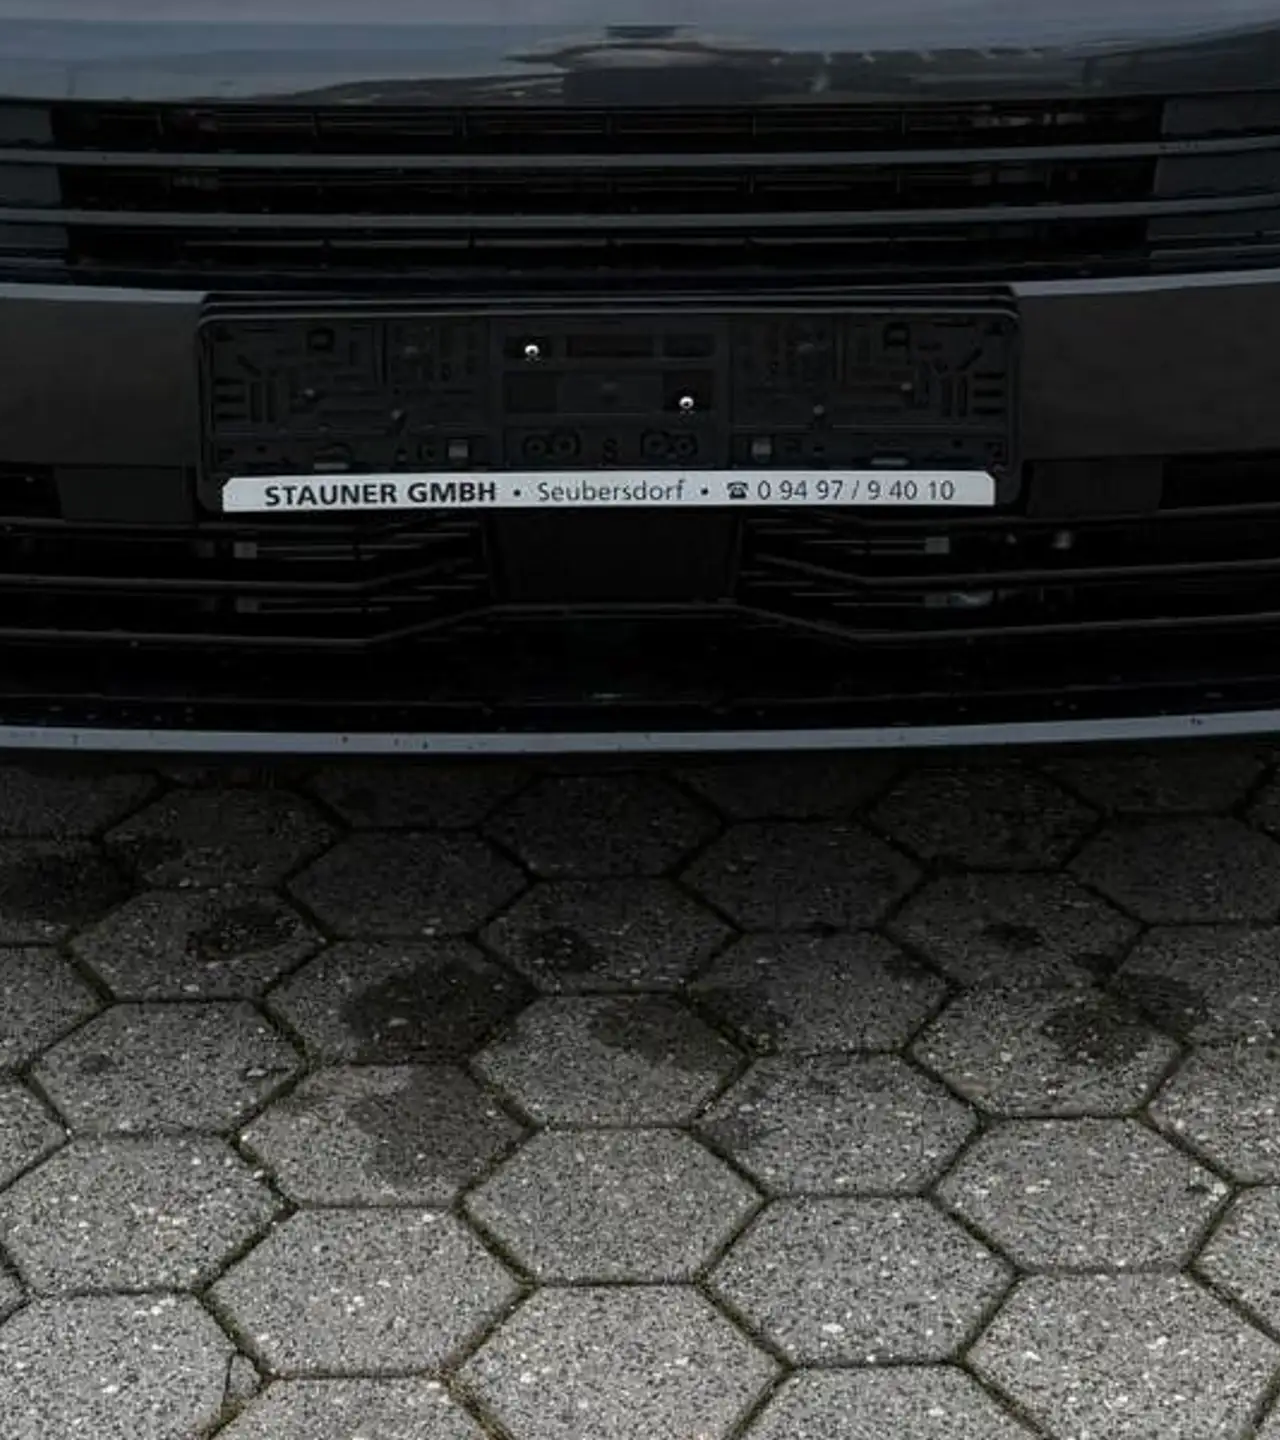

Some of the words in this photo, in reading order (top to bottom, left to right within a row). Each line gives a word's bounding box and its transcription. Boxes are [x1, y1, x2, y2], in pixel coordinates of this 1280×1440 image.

[264, 483, 398, 506] STAUNER
[407, 481, 496, 503] GMBH
[537, 479, 685, 501] Seubersdorf
[757, 479, 771, 500] 0
[780, 479, 808, 500] 94
[816, 479, 843, 500] 97
[867, 479, 881, 500] 9
[889, 479, 918, 501] 40
[929, 480, 955, 501] 10
